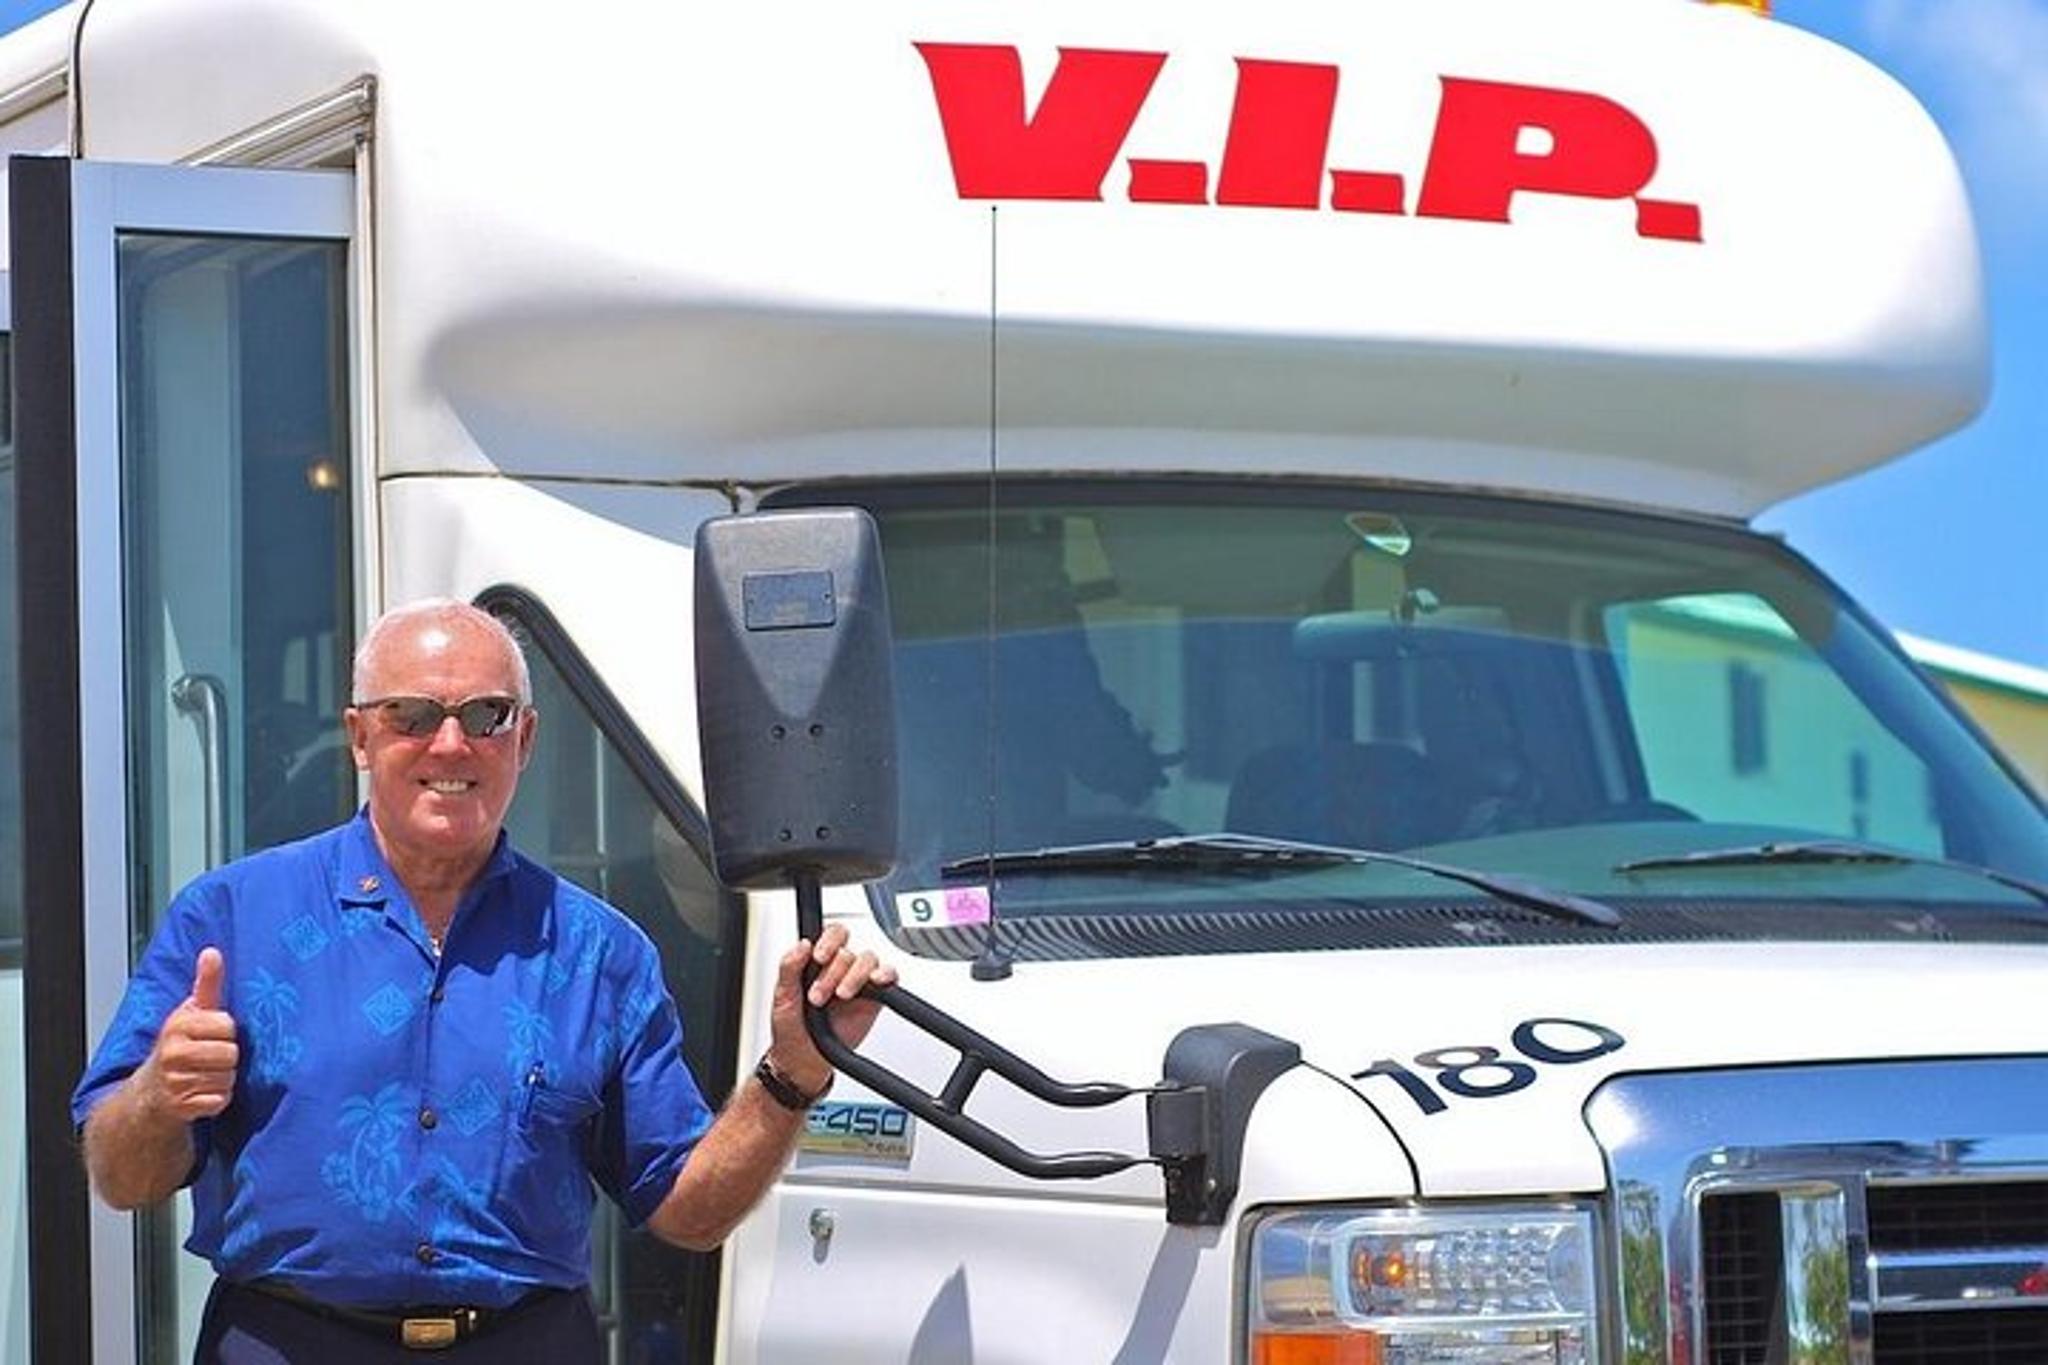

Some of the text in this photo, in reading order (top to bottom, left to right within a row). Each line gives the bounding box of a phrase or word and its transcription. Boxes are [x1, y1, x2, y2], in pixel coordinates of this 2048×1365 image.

[912, 42, 1704, 243] V.I.P.
[911, 898, 933, 922] 9
[1351, 1017, 1626, 1115] 180
